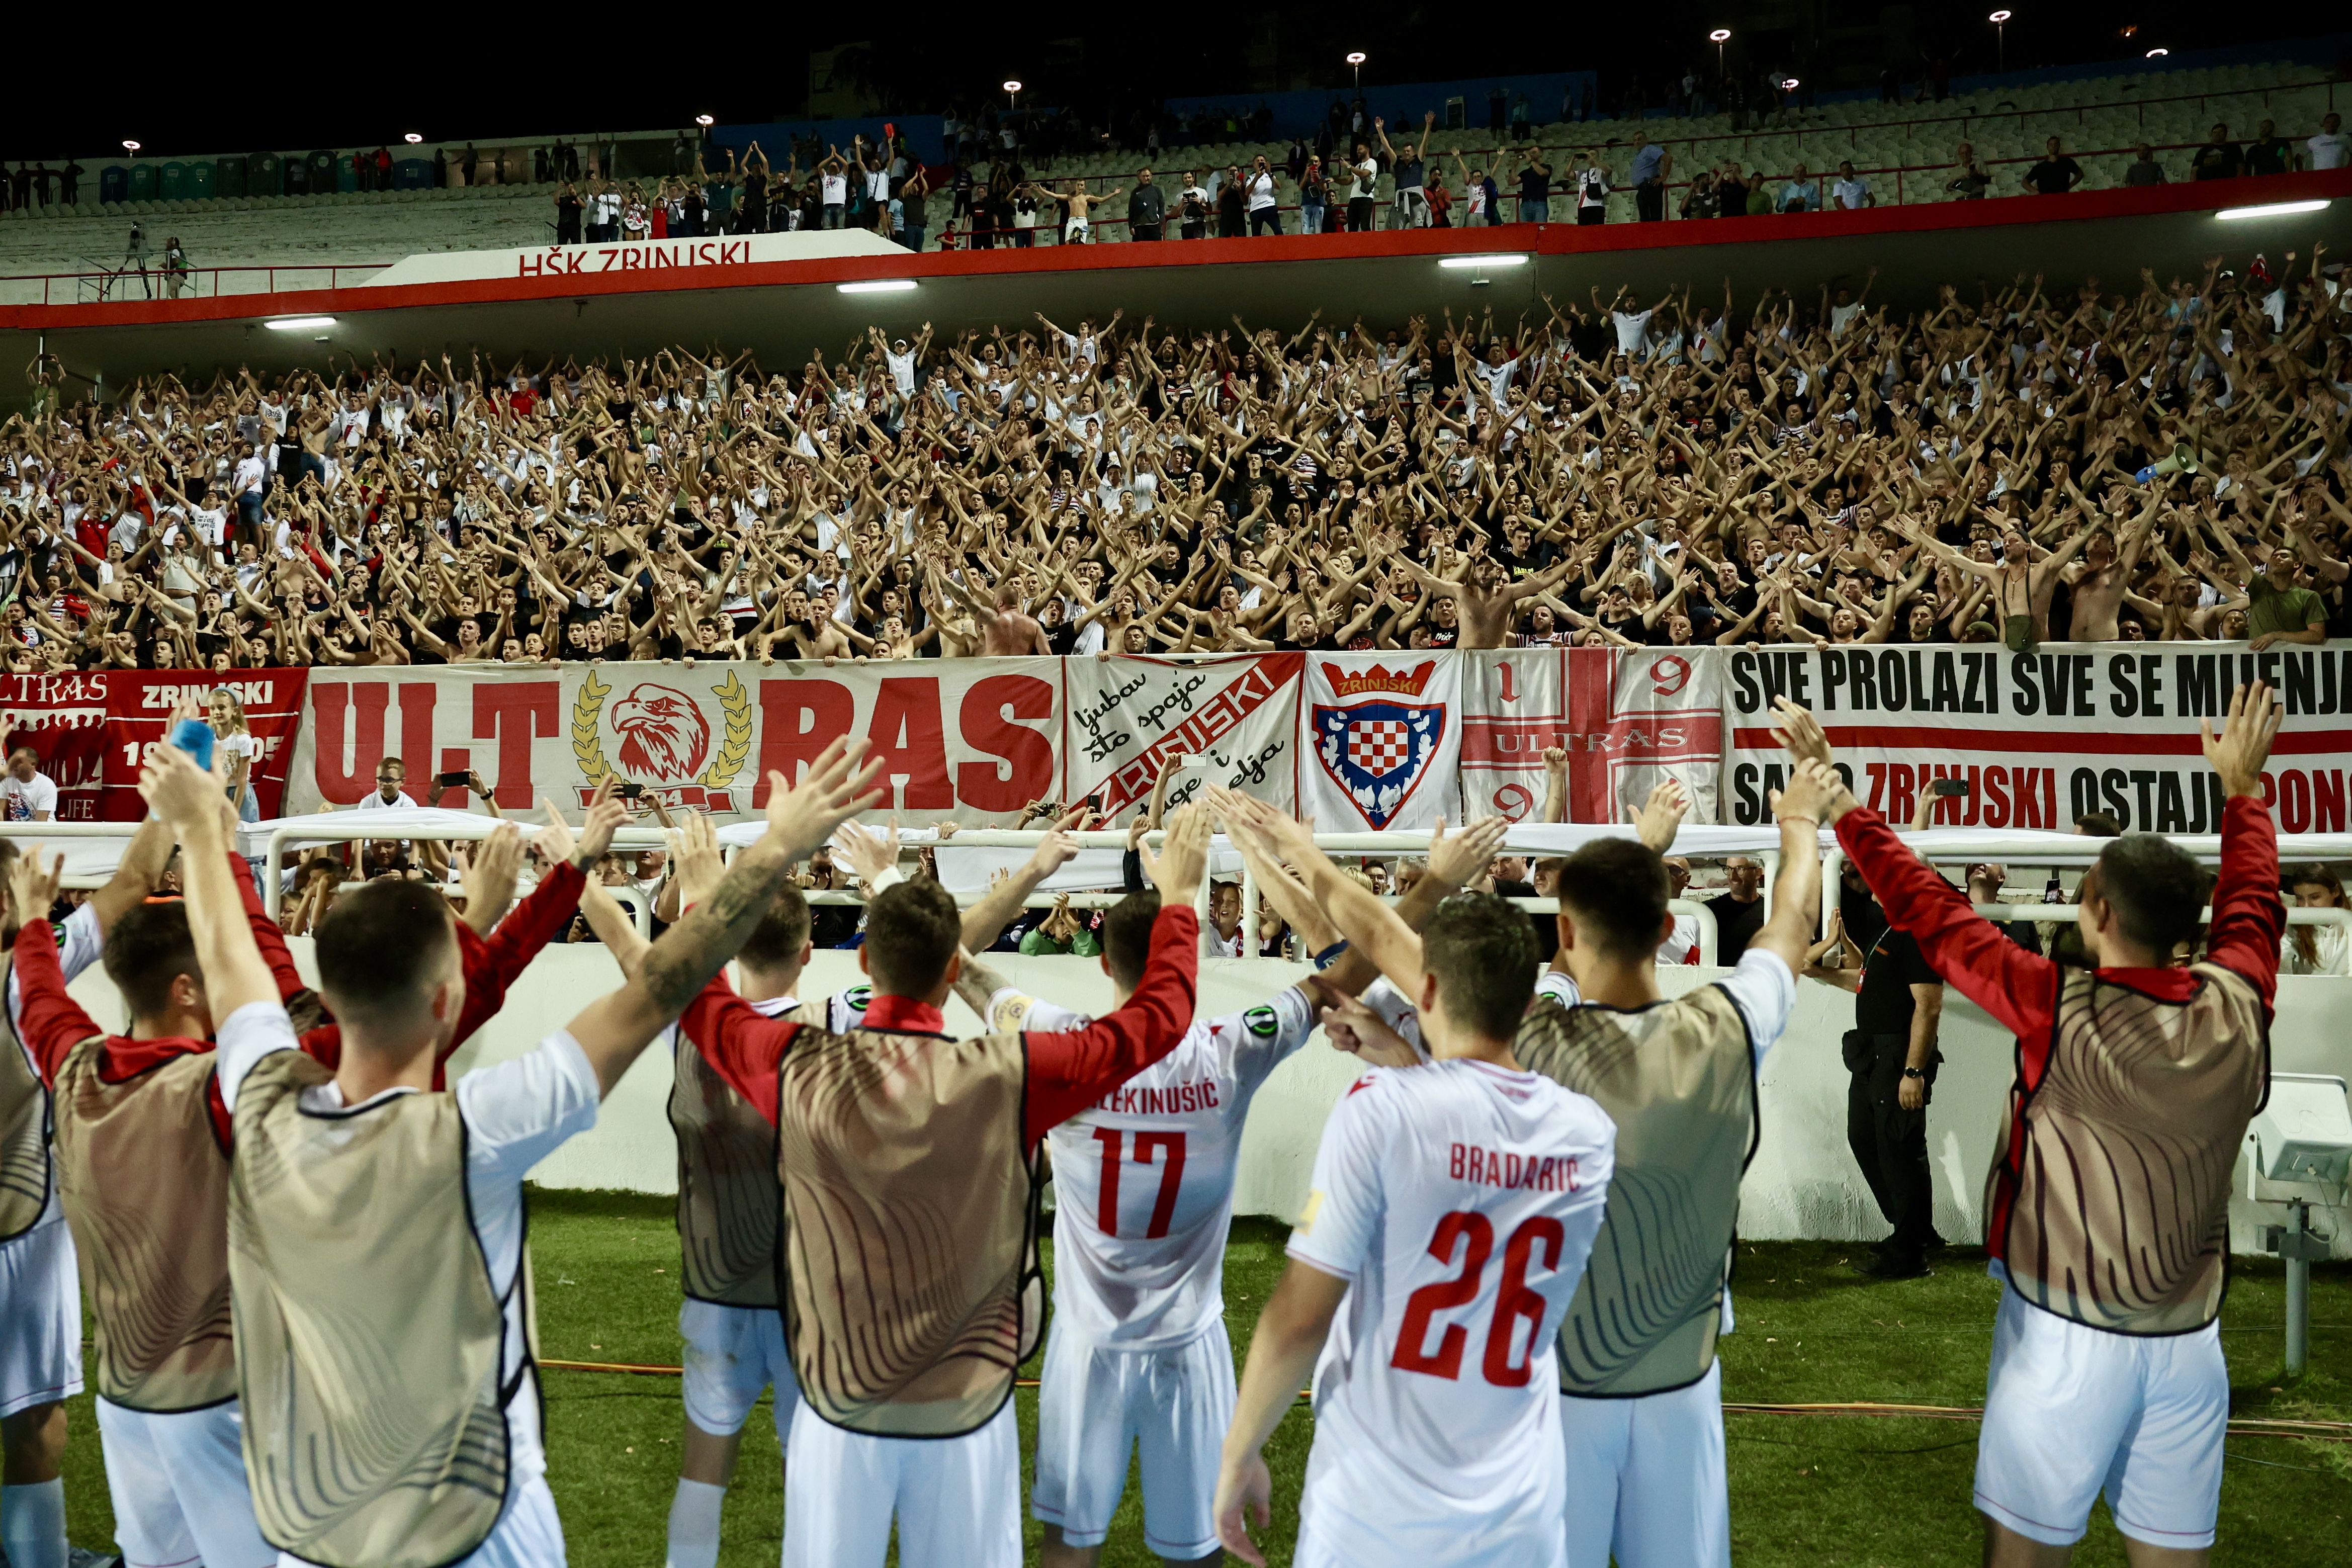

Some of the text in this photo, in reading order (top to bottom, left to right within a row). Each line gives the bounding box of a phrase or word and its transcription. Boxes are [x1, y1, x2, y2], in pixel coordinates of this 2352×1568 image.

[142, 680, 273, 708] ZRINSKI
[1338, 678, 1418, 695] ZRINJSKI
[1493, 661, 1521, 702] 1
[1649, 655, 1691, 696] 9
[1731, 652, 1812, 714] SVE
[1820, 649, 1999, 714] PROLAZI
[2012, 653, 2096, 716] SVE
[2108, 654, 2164, 718] SE
[1495, 727, 1688, 753] ULTRAS
[1219, 740, 1284, 800] elja
[59, 799, 95, 819] IFE
[1866, 762, 2057, 829] ZRINJSKI
[2259, 769, 2352, 834] PON
[1091, 1078, 1219, 1114] LEKINUŠIĆ
[1093, 1126, 1186, 1239] 17
[1390, 1209, 1565, 1388] 26
